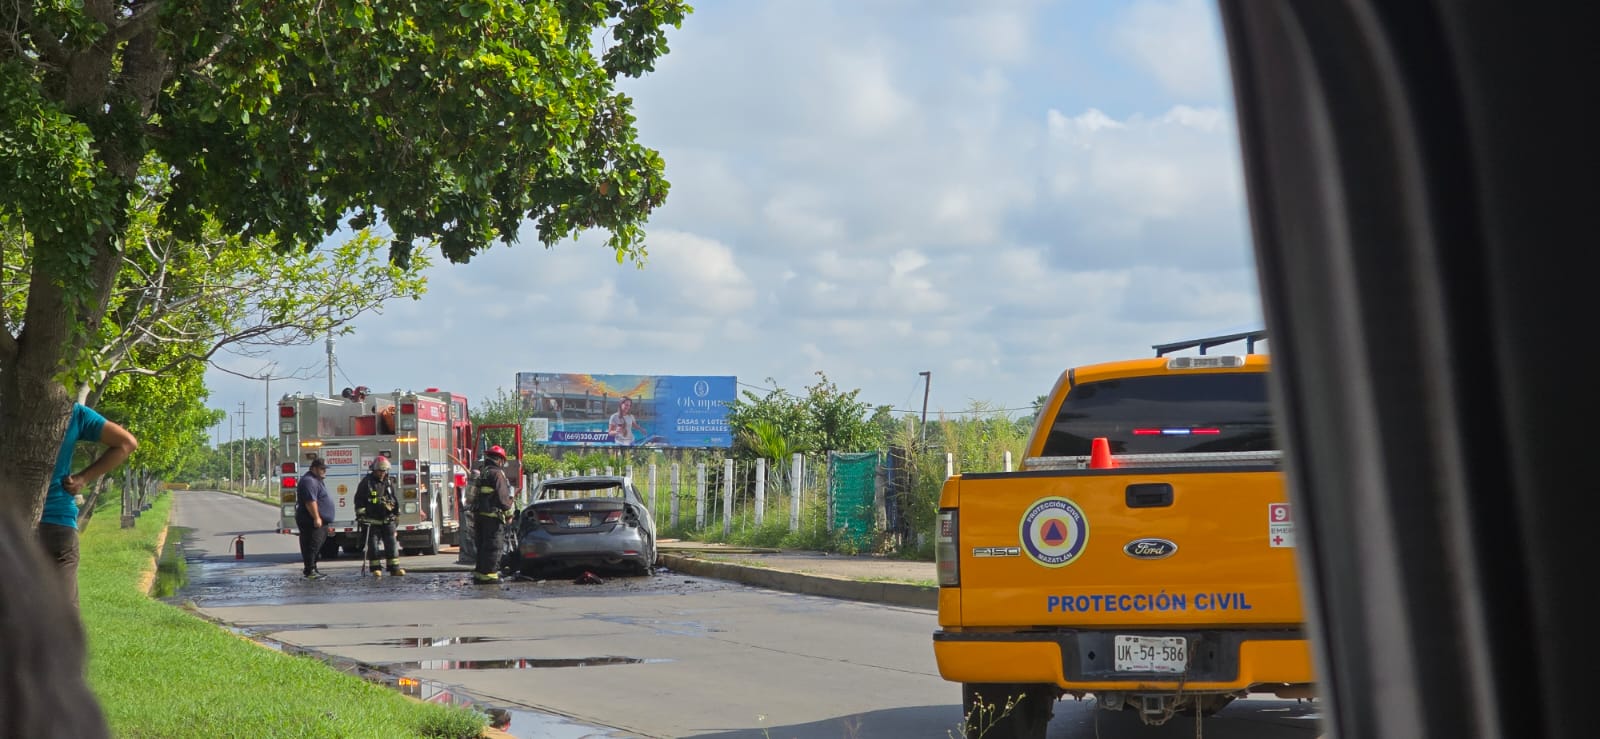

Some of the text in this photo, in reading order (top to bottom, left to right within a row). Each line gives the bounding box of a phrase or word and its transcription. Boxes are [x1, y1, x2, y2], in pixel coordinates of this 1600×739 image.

[326, 449, 353, 457] BOMBEROS
[339, 497, 346, 508] 5
[1026, 501, 1081, 523] PROTECCIÓN CIVIL
[1274, 507, 1287, 521] 9
[1134, 542, 1166, 555] Ford
[1037, 552, 1073, 564] MAZATLÁN
[1047, 589, 1253, 613] PROTECCIÓN CIVIL
[1117, 645, 1184, 662] UK-54-586
